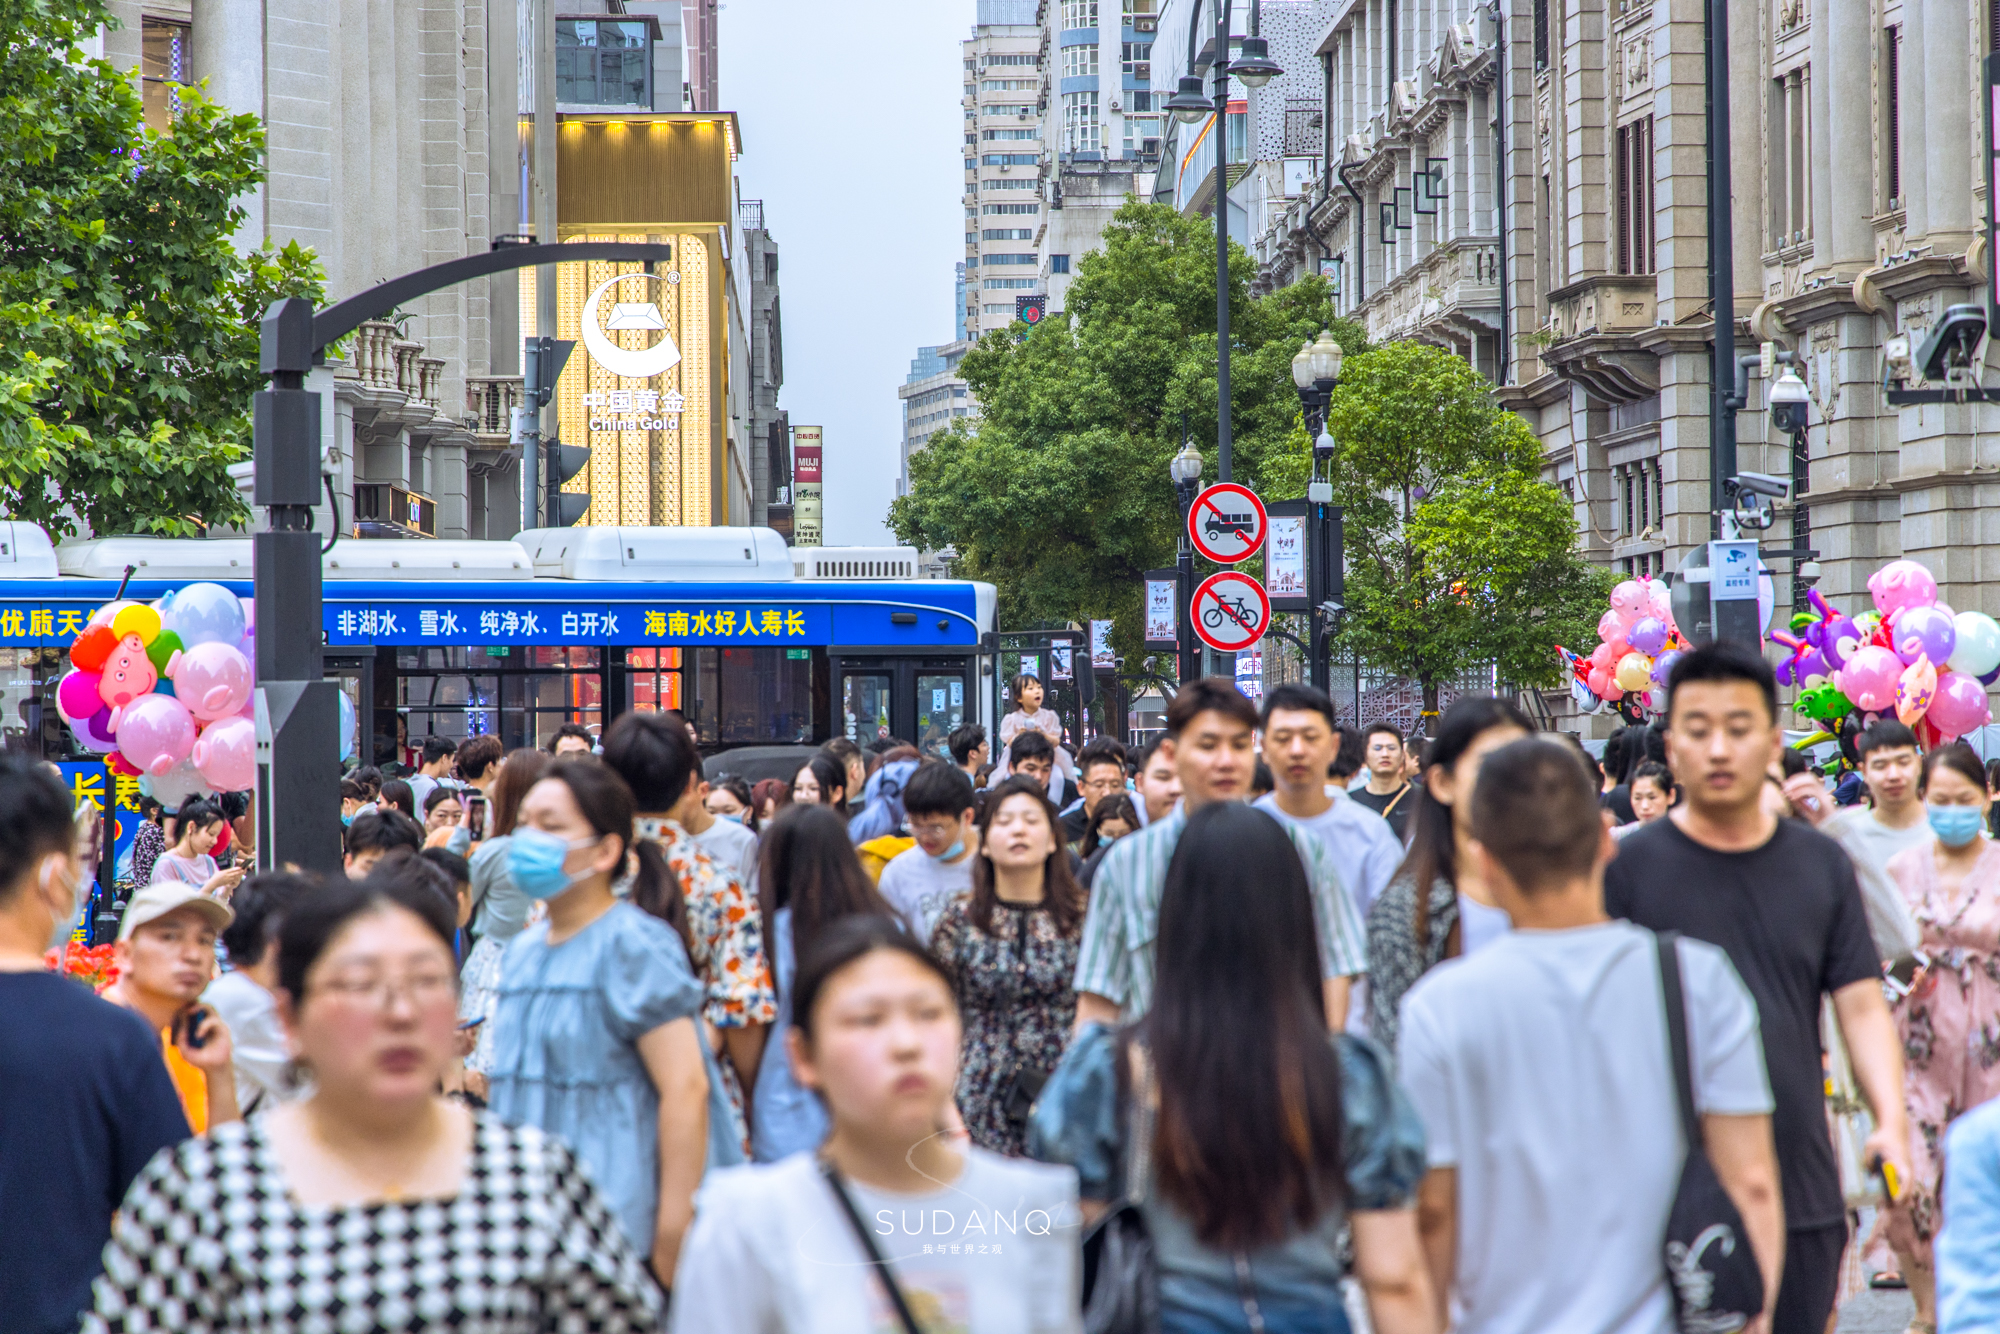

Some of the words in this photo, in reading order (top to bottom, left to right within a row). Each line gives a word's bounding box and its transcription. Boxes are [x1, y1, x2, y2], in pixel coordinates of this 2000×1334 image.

[582, 388, 686, 414] 中国黄金
[589, 417, 636, 431] China
[640, 417, 678, 431] Gold
[798, 458, 818, 466] MUJI
[0, 609, 96, 637] 优质天
[338, 610, 619, 636] 非湖水、雪水、纯净水、白开水
[644, 610, 806, 637] 海南水好人寿长
